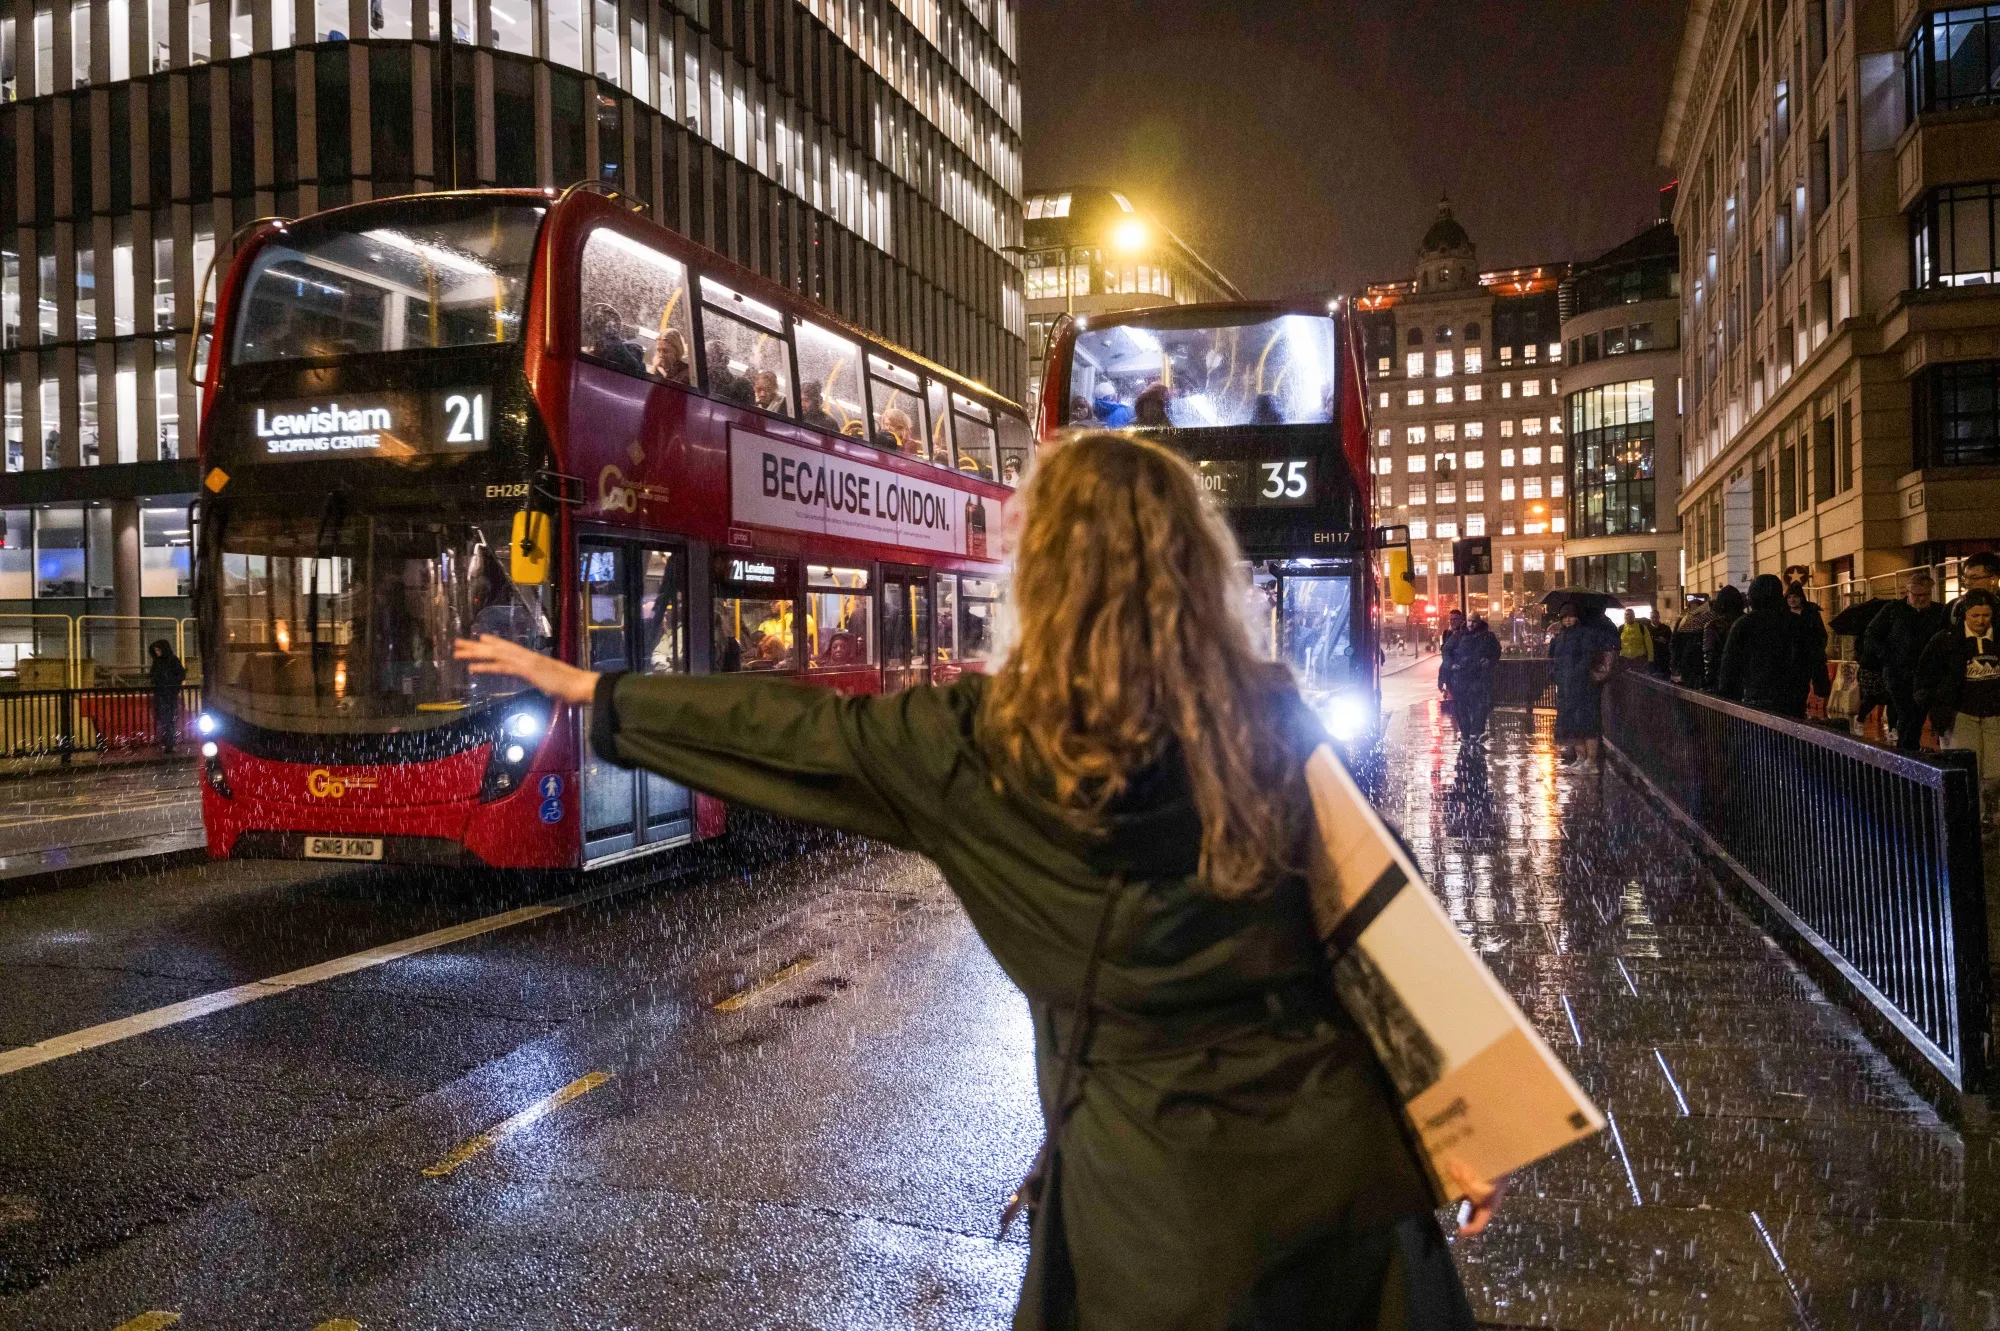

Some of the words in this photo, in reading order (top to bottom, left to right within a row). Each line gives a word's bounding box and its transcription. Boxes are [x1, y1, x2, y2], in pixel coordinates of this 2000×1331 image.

[256, 403, 392, 437] Lewisham
[445, 393, 485, 443] 21
[267, 437, 330, 454] SHOPPING
[331, 434, 381, 450] CENTRE
[485, 483, 529, 498] EH284
[762, 452, 871, 517] BECAUSE
[875, 480, 950, 531] LONDON.
[1261, 461, 1308, 499] 35
[1313, 532, 1350, 543] EH117
[732, 559, 743, 580] 21
[308, 768, 345, 798] Go
